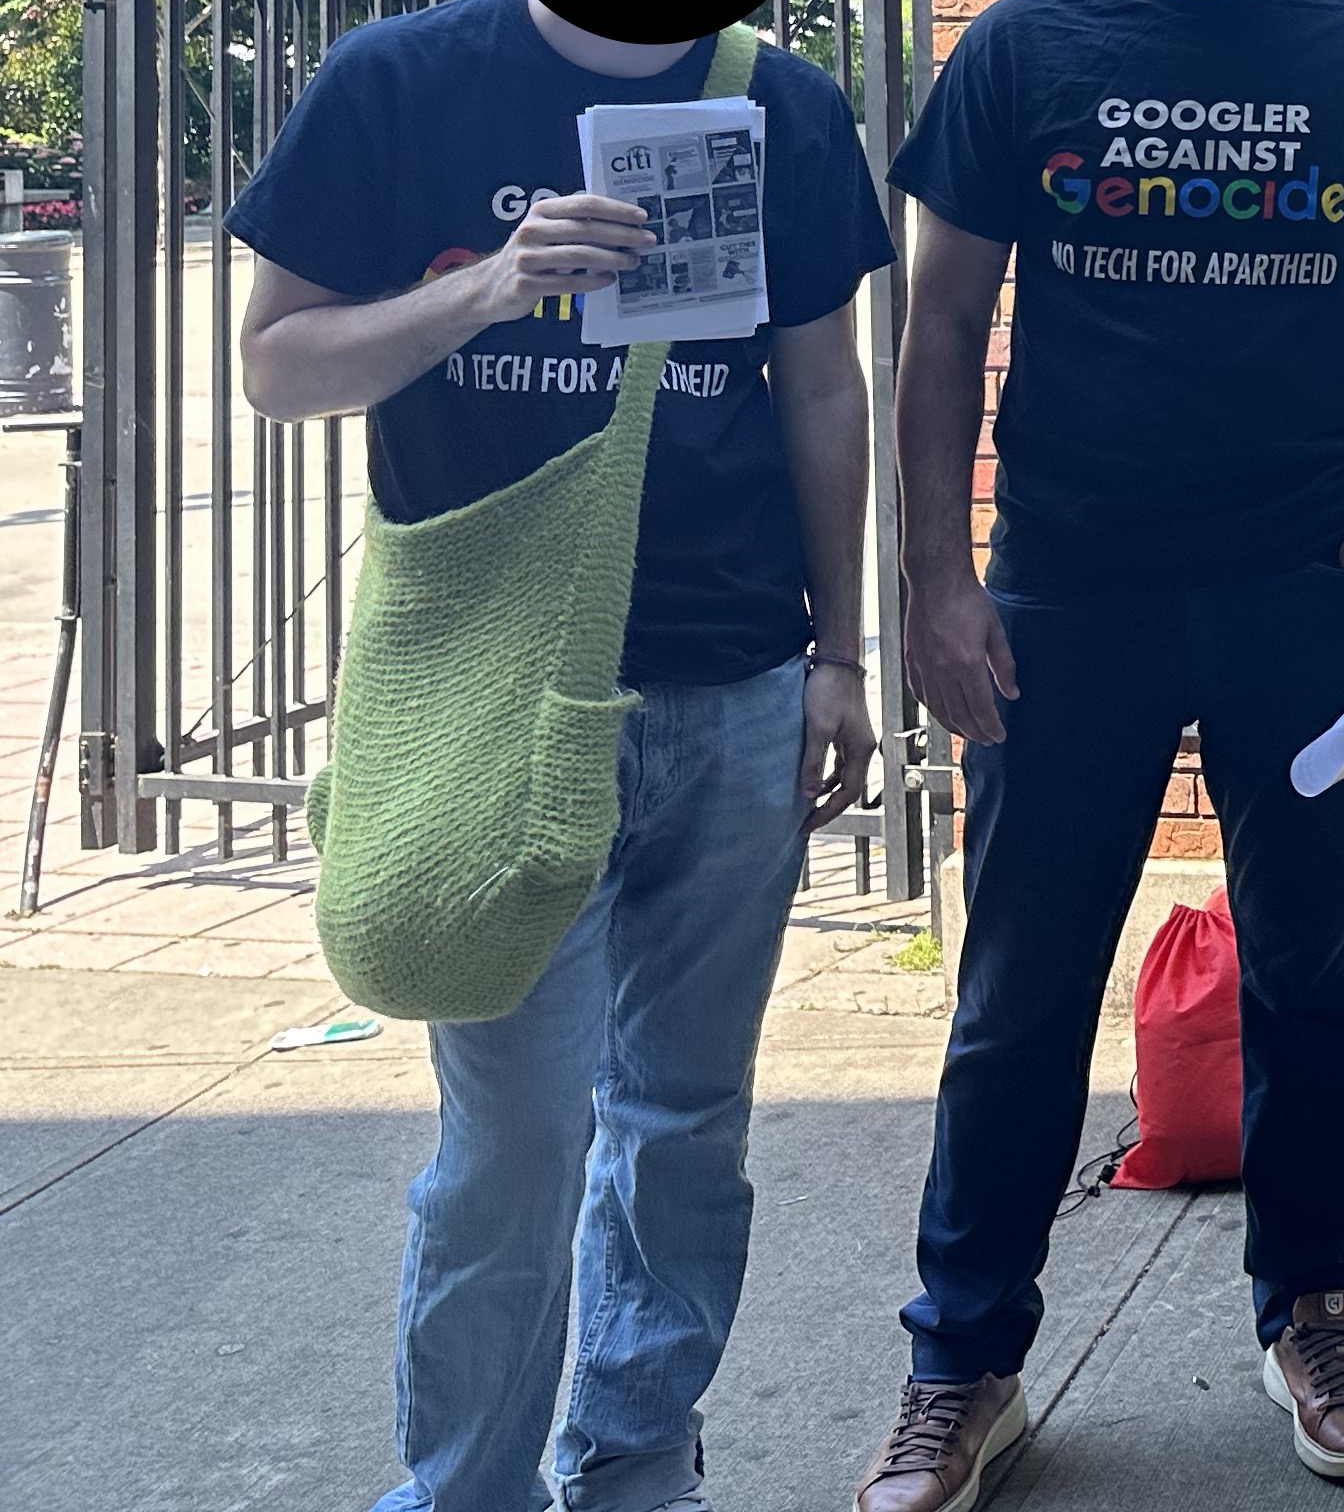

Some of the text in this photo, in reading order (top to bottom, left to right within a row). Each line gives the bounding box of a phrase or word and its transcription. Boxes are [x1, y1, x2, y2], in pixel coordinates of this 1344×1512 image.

[1098, 98, 1310, 134] GOOGLER
[1100, 137, 1301, 172] AGAINST
[1051, 240, 1337, 286] NO TECH FOR APARTHEID
[472, 354, 532, 392] TECH
[541, 357, 597, 393] FOR
